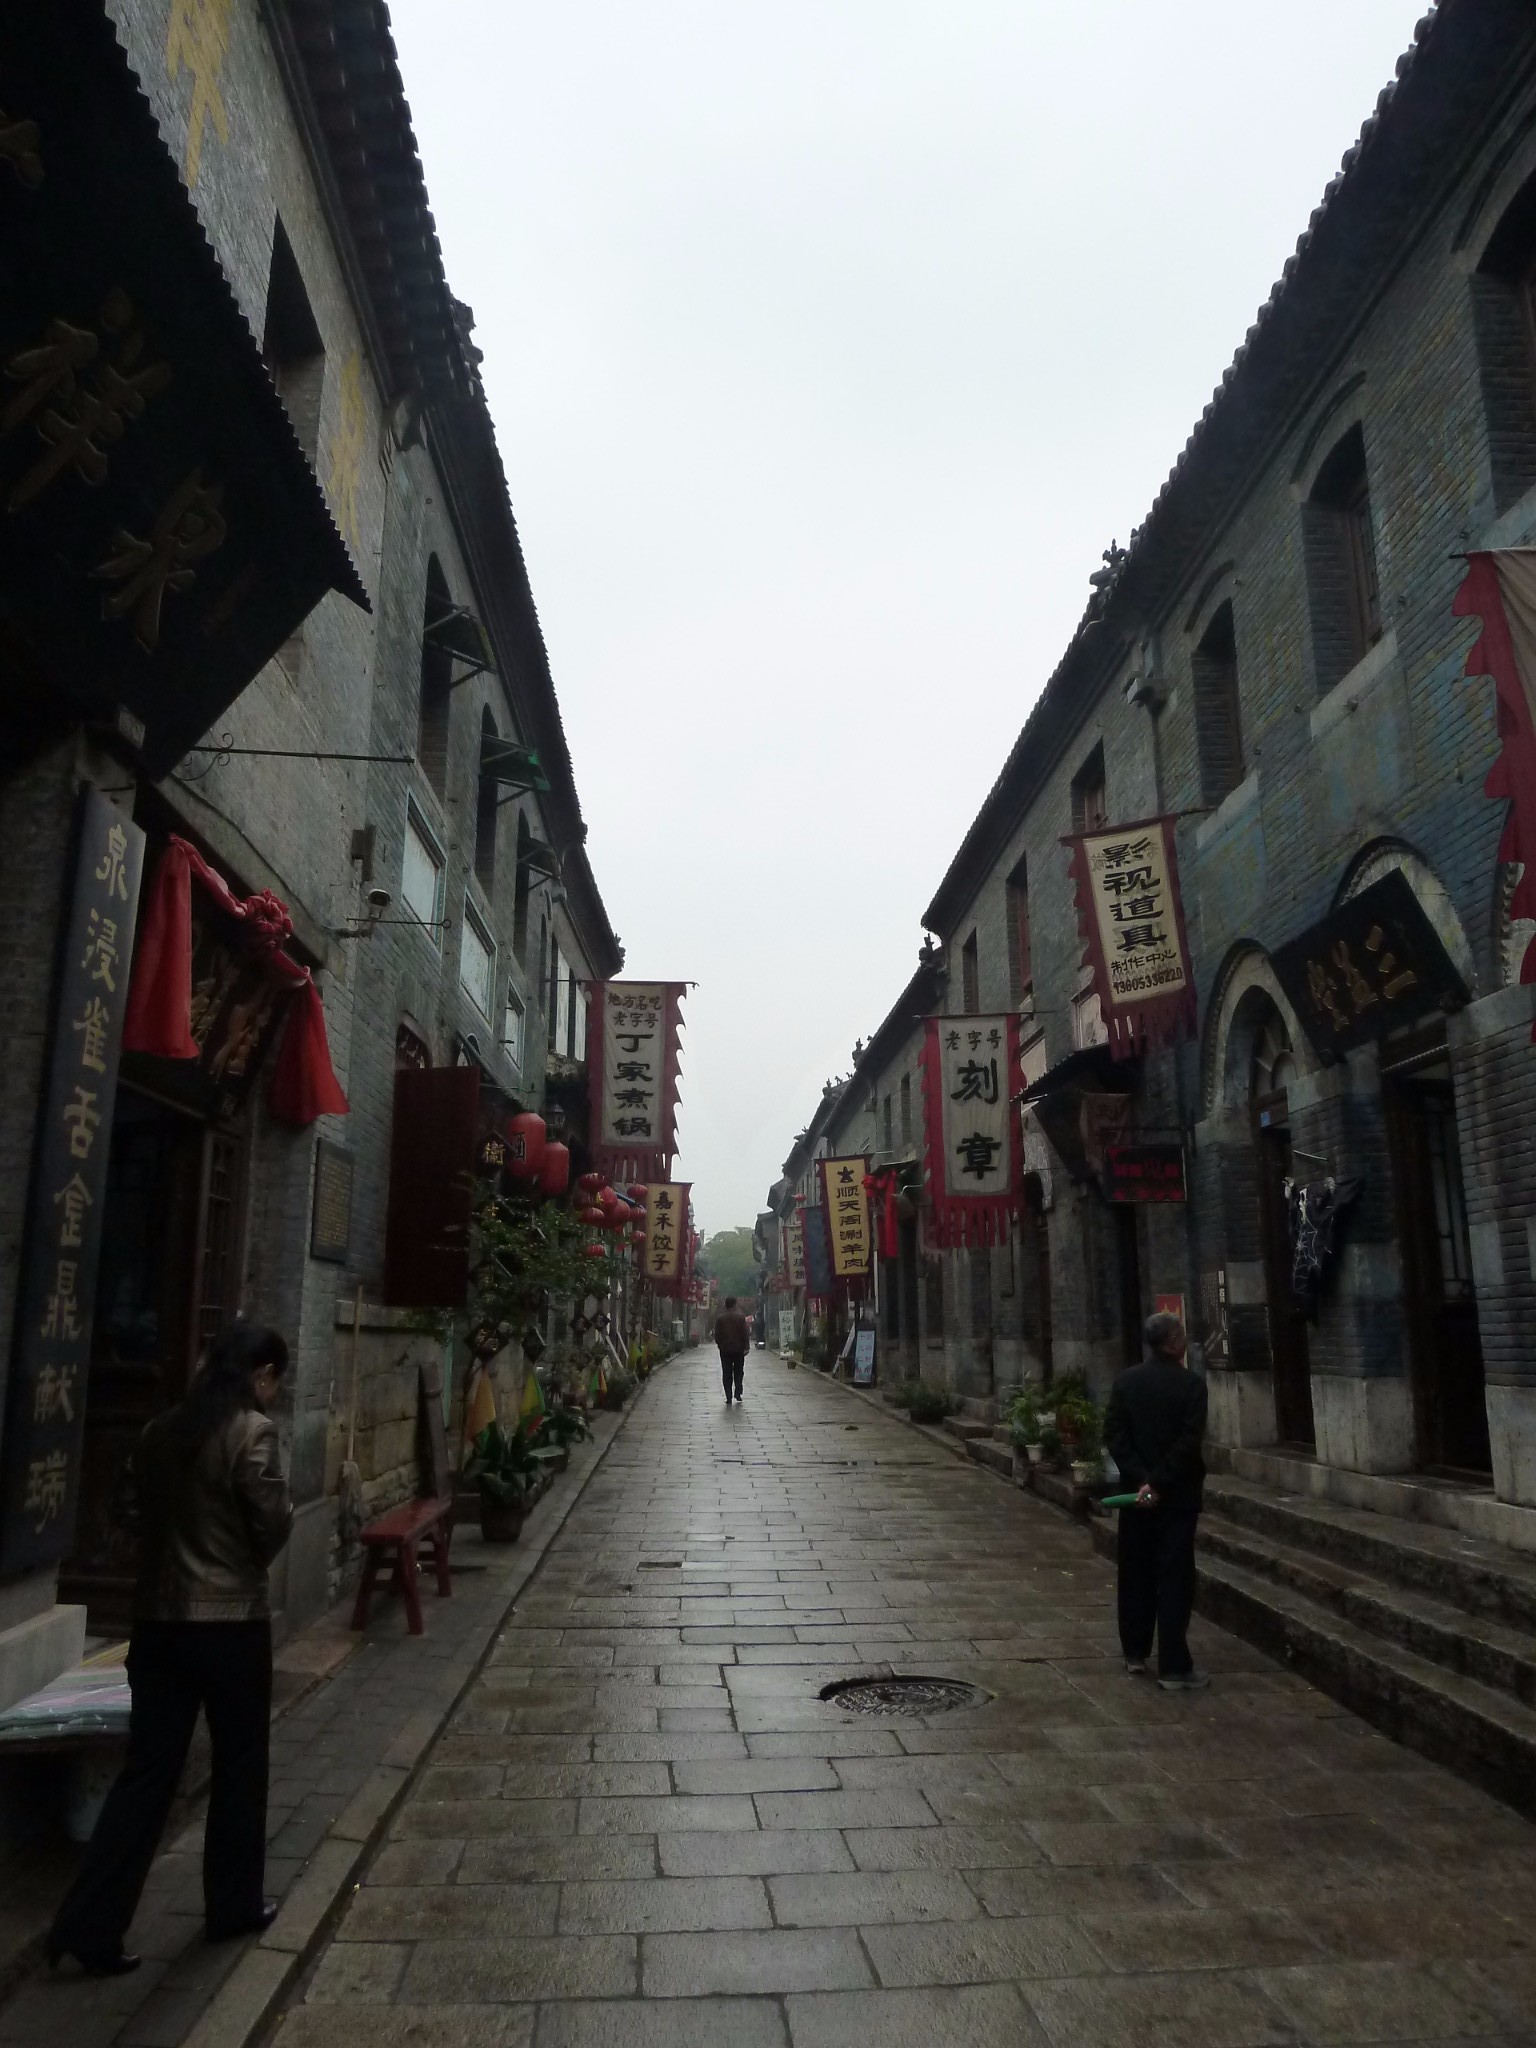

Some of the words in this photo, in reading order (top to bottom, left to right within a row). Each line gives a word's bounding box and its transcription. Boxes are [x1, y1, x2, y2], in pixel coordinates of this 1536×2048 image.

[1103, 837, 1167, 951] 影视道具
[1111, 949, 1176, 975] 制作中心
[608, 992, 662, 1010] 地方名吃
[613, 1011, 658, 1028] 老字号
[945, 1029, 1001, 1051] 老字号
[612, 1034, 654, 1138] 丁家煮锅
[951, 1058, 1001, 1180] 刻章
[651, 1190, 675, 1272] 嘉禾饺子
